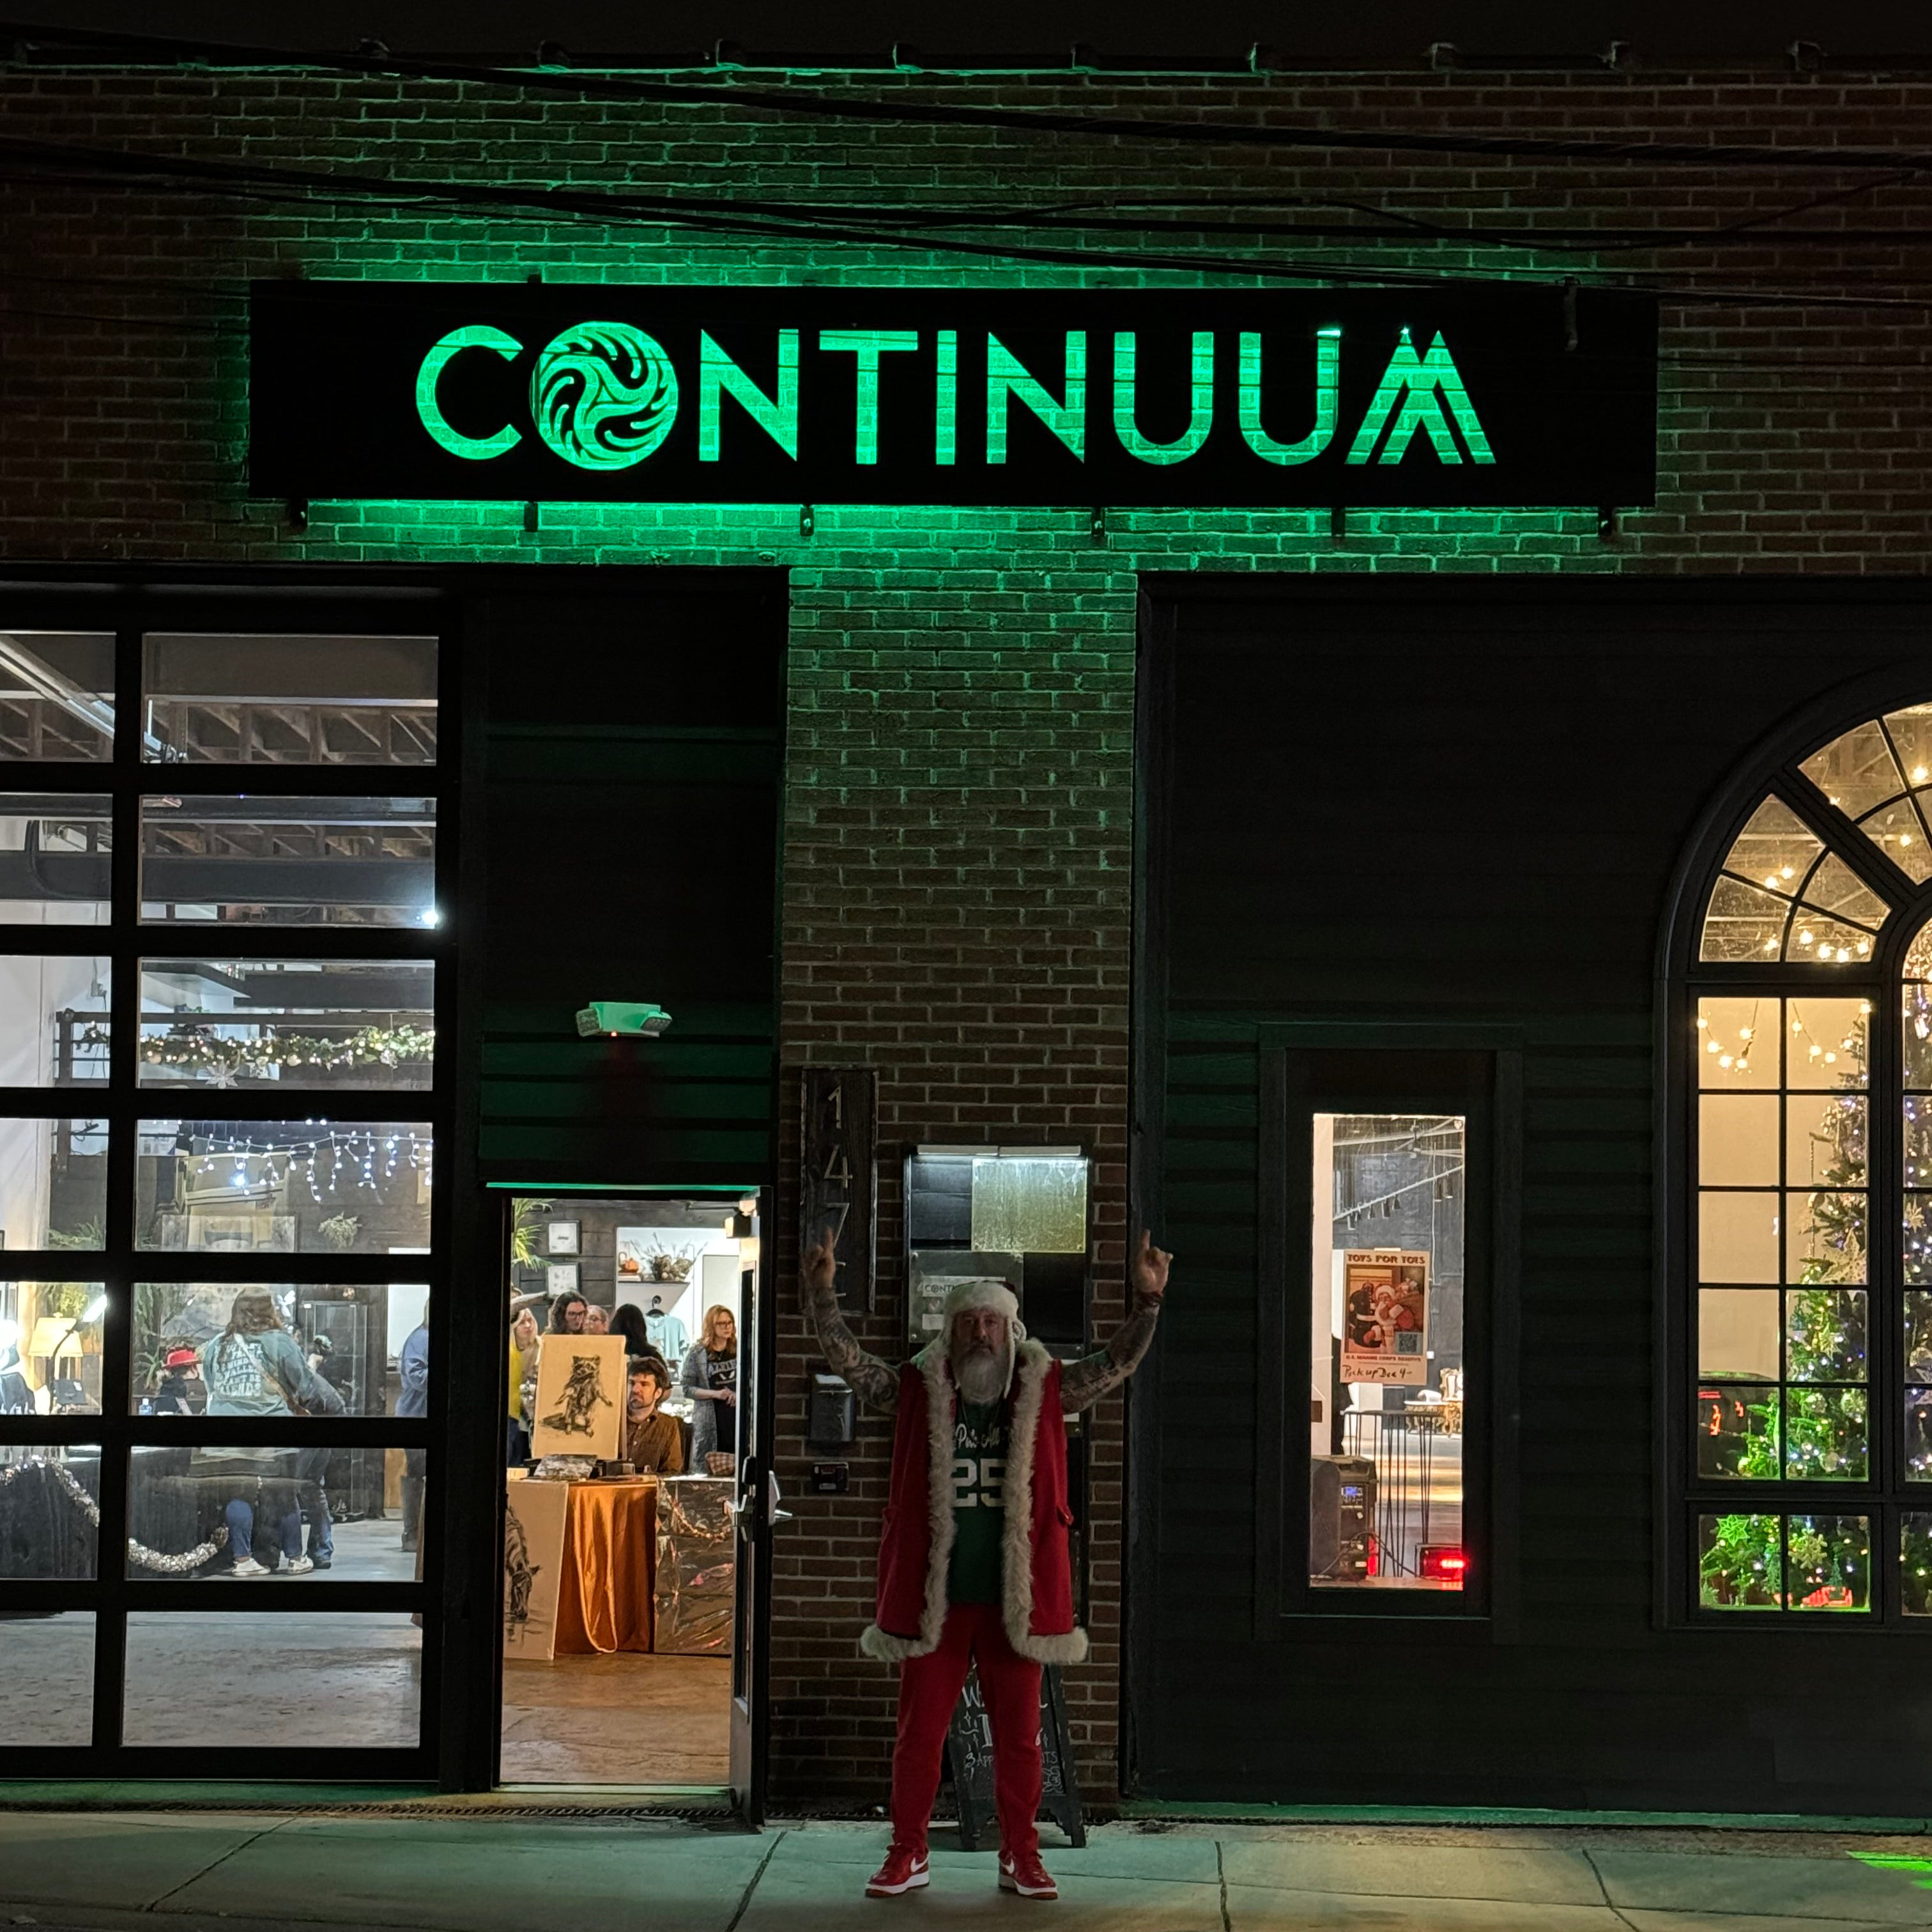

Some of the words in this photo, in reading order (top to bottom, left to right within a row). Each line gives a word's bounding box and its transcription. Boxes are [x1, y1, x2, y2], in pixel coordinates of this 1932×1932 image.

[415, 321, 1498, 471] CONTINUUM
[1347, 1254, 1372, 1262] TOYS
[1376, 1255, 1398, 1263] FOR
[1402, 1255, 1425, 1264] TOTS
[951, 1458, 1008, 1508] 25
